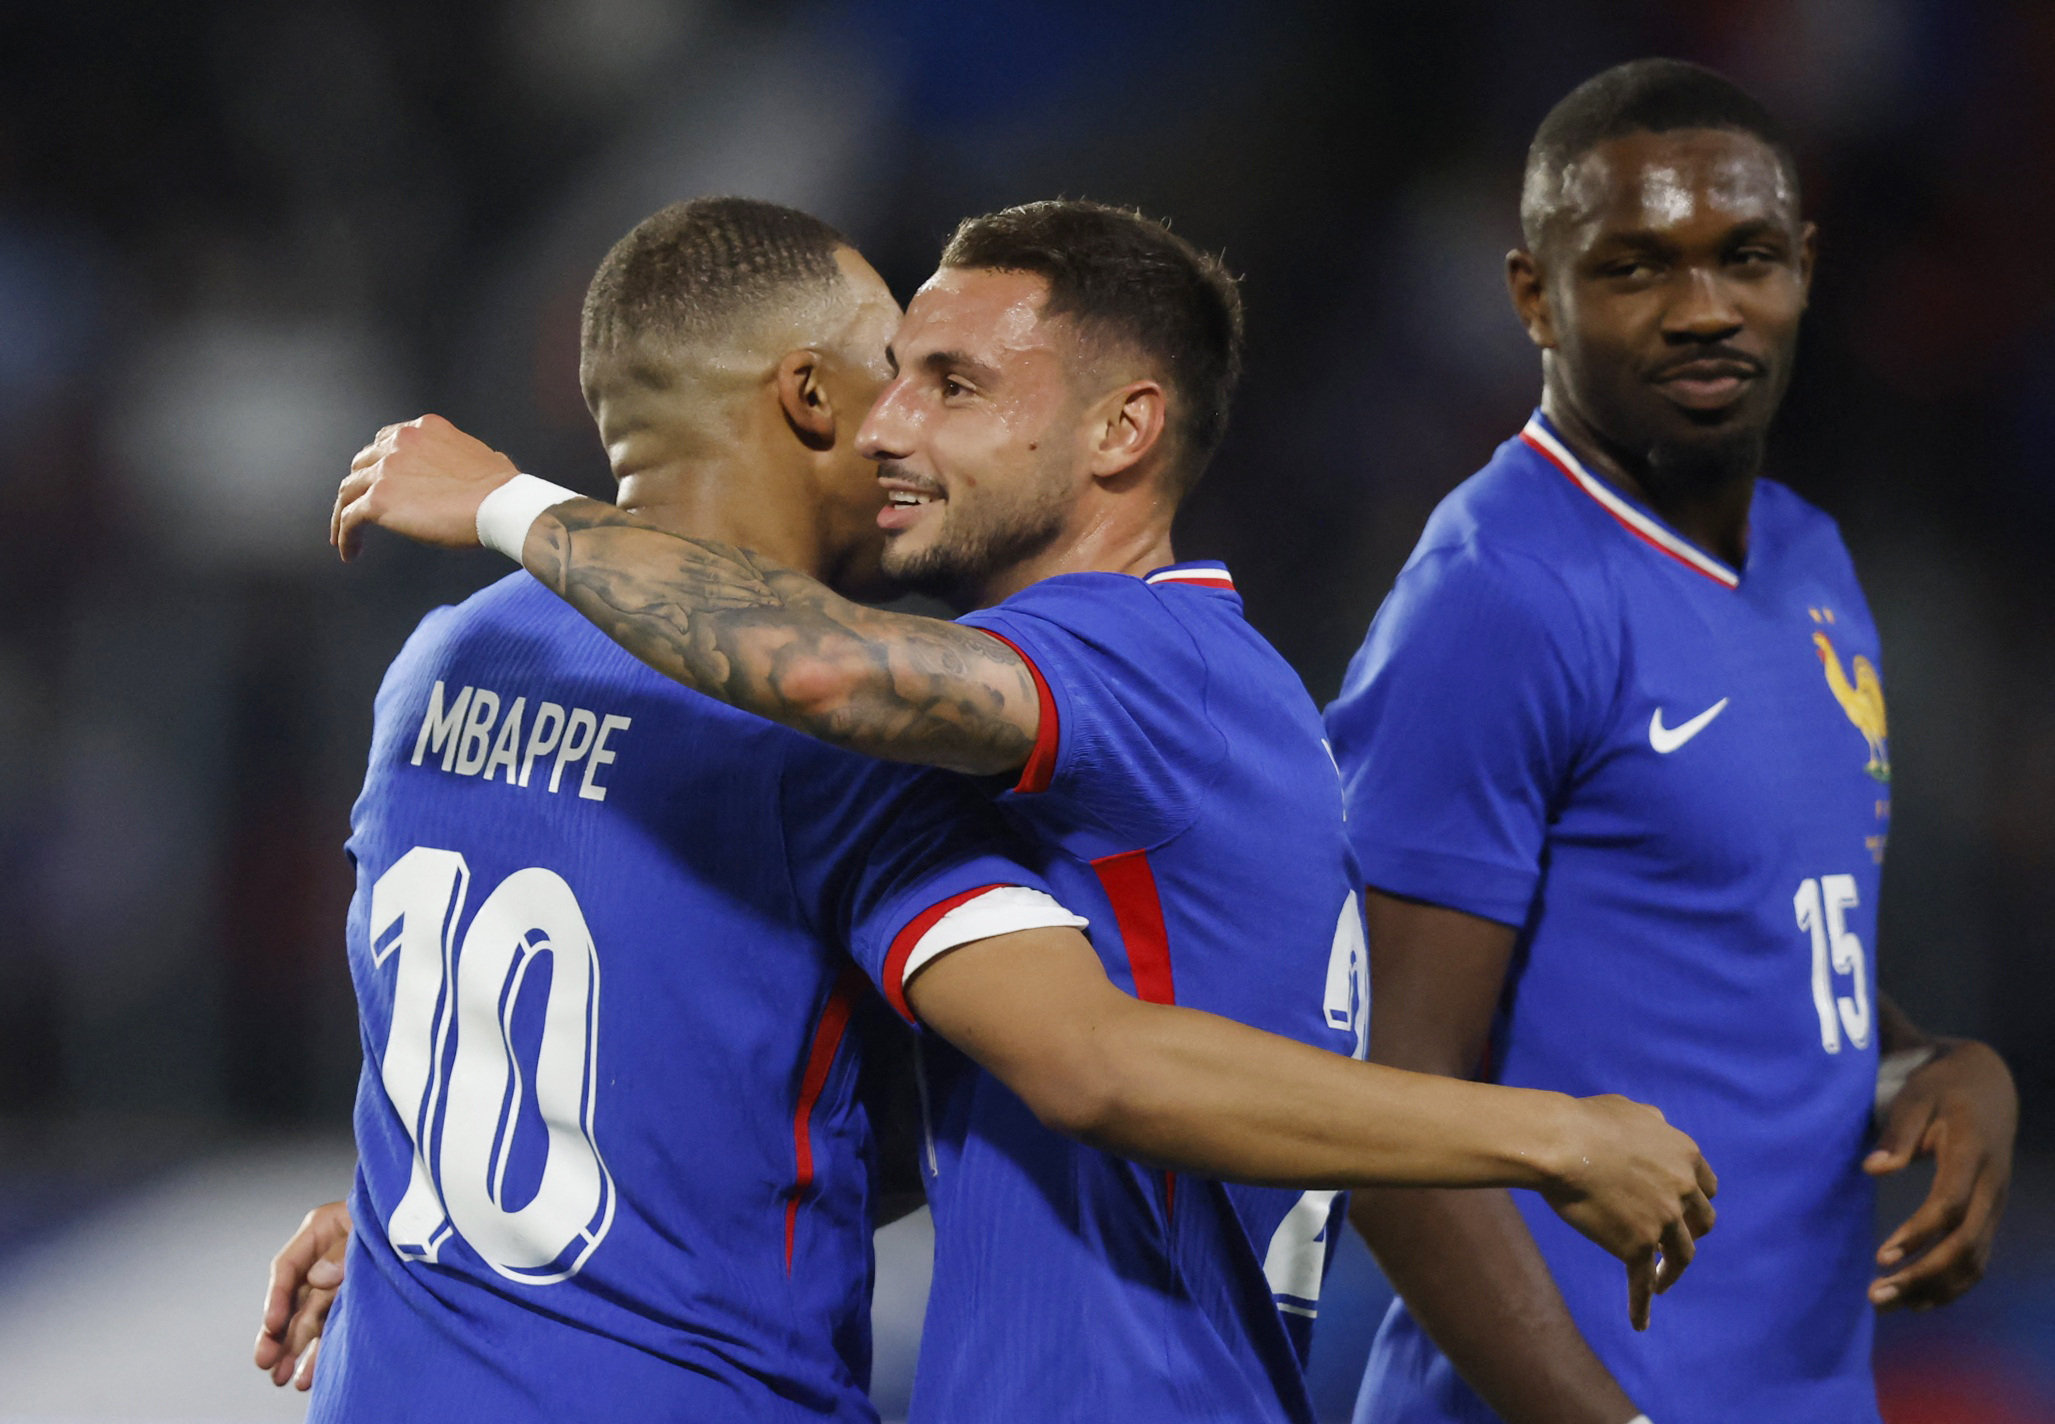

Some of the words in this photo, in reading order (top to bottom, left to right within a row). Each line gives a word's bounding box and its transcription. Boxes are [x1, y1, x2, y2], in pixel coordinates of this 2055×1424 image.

[411, 680, 631, 801] MBAPPE
[1793, 874, 1870, 1054] 15
[369, 846, 616, 1285] 10
